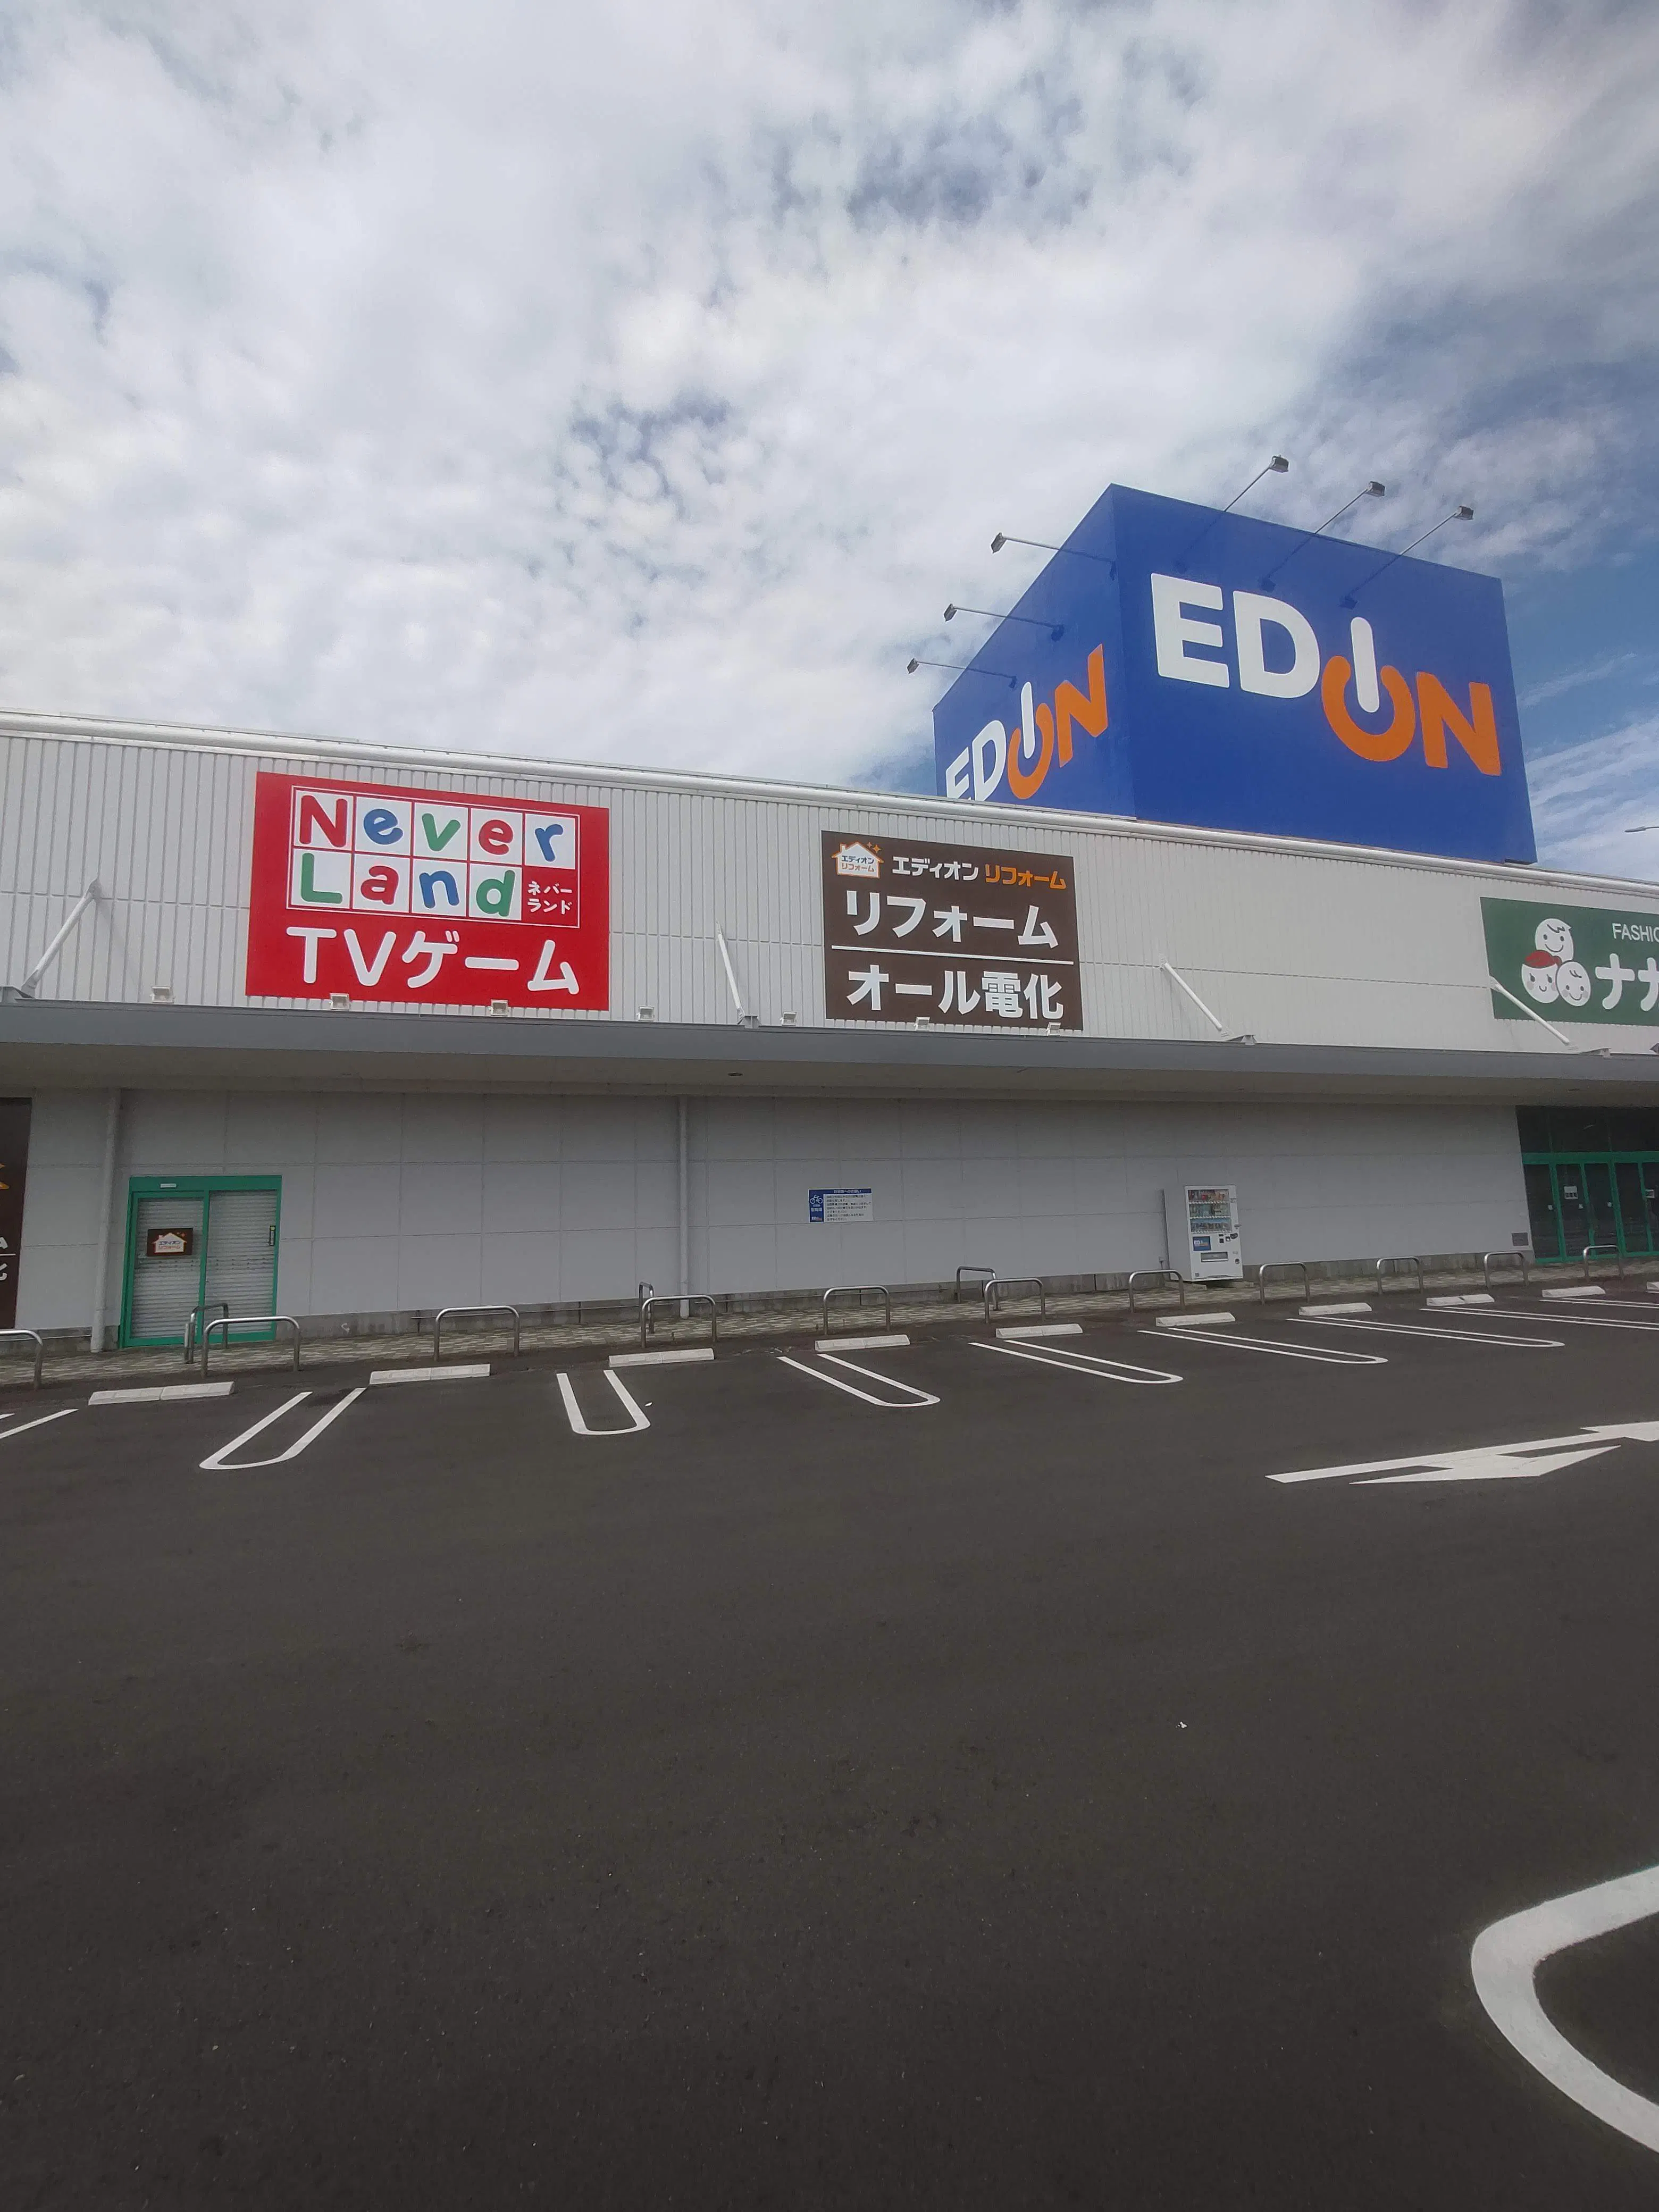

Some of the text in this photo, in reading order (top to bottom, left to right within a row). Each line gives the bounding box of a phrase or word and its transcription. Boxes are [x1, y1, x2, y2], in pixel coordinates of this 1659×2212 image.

[1151, 573, 1501, 776] EDION
[945, 643, 1108, 802] EDION
[299, 795, 564, 862] Never
[301, 852, 516, 917] Land
[527, 881, 573, 895] ネバー
[841, 855, 875, 864] エディオン
[842, 863, 875, 872] リフォーム
[892, 856, 1067, 890] エディオン リフォーム
[527, 898, 573, 915] ランド
[846, 890, 1059, 949] リフォーム
[286, 926, 580, 995] TVゲーム
[847, 965, 1064, 1020] オール電化
